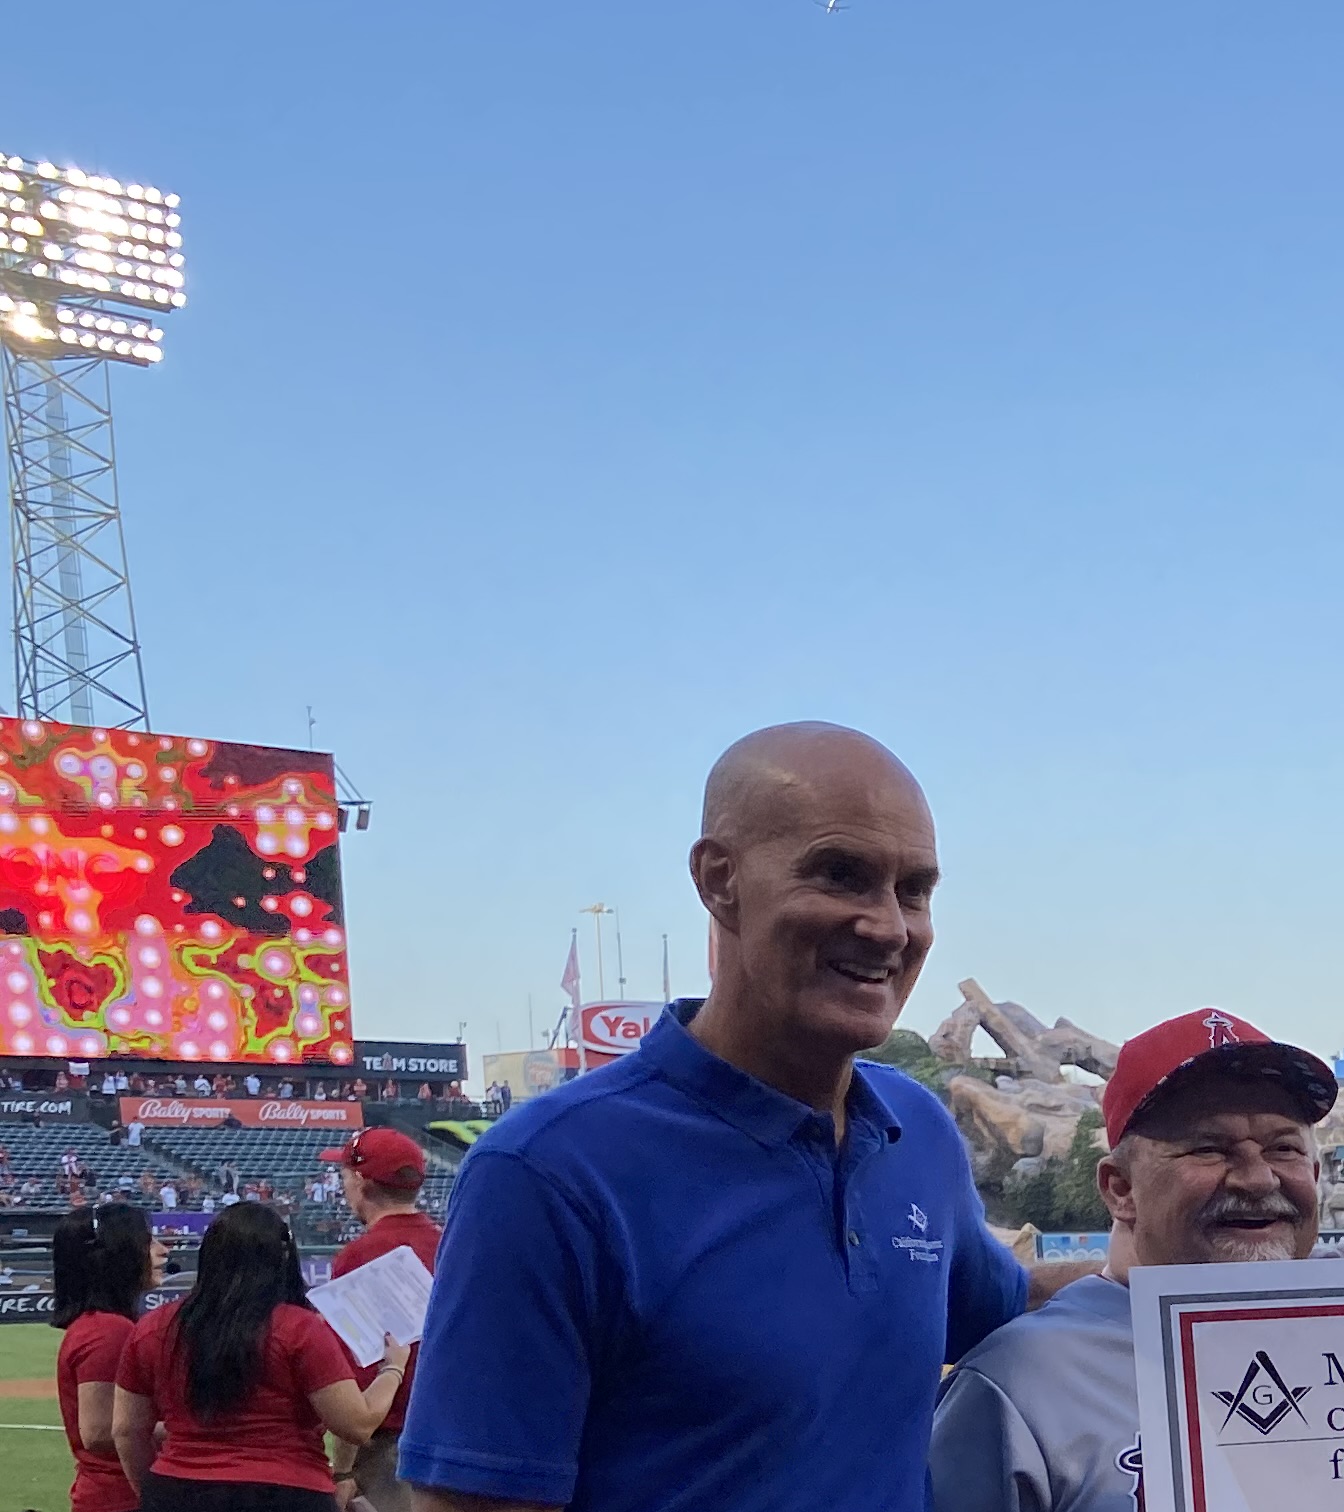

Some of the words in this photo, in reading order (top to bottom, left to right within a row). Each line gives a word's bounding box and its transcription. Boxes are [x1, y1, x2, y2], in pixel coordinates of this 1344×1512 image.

[408, 1058, 458, 1073] STORE
[138, 1098, 193, 1123] Bally
[258, 1101, 311, 1125] Bally
[310, 1108, 347, 1120] SPORTS
